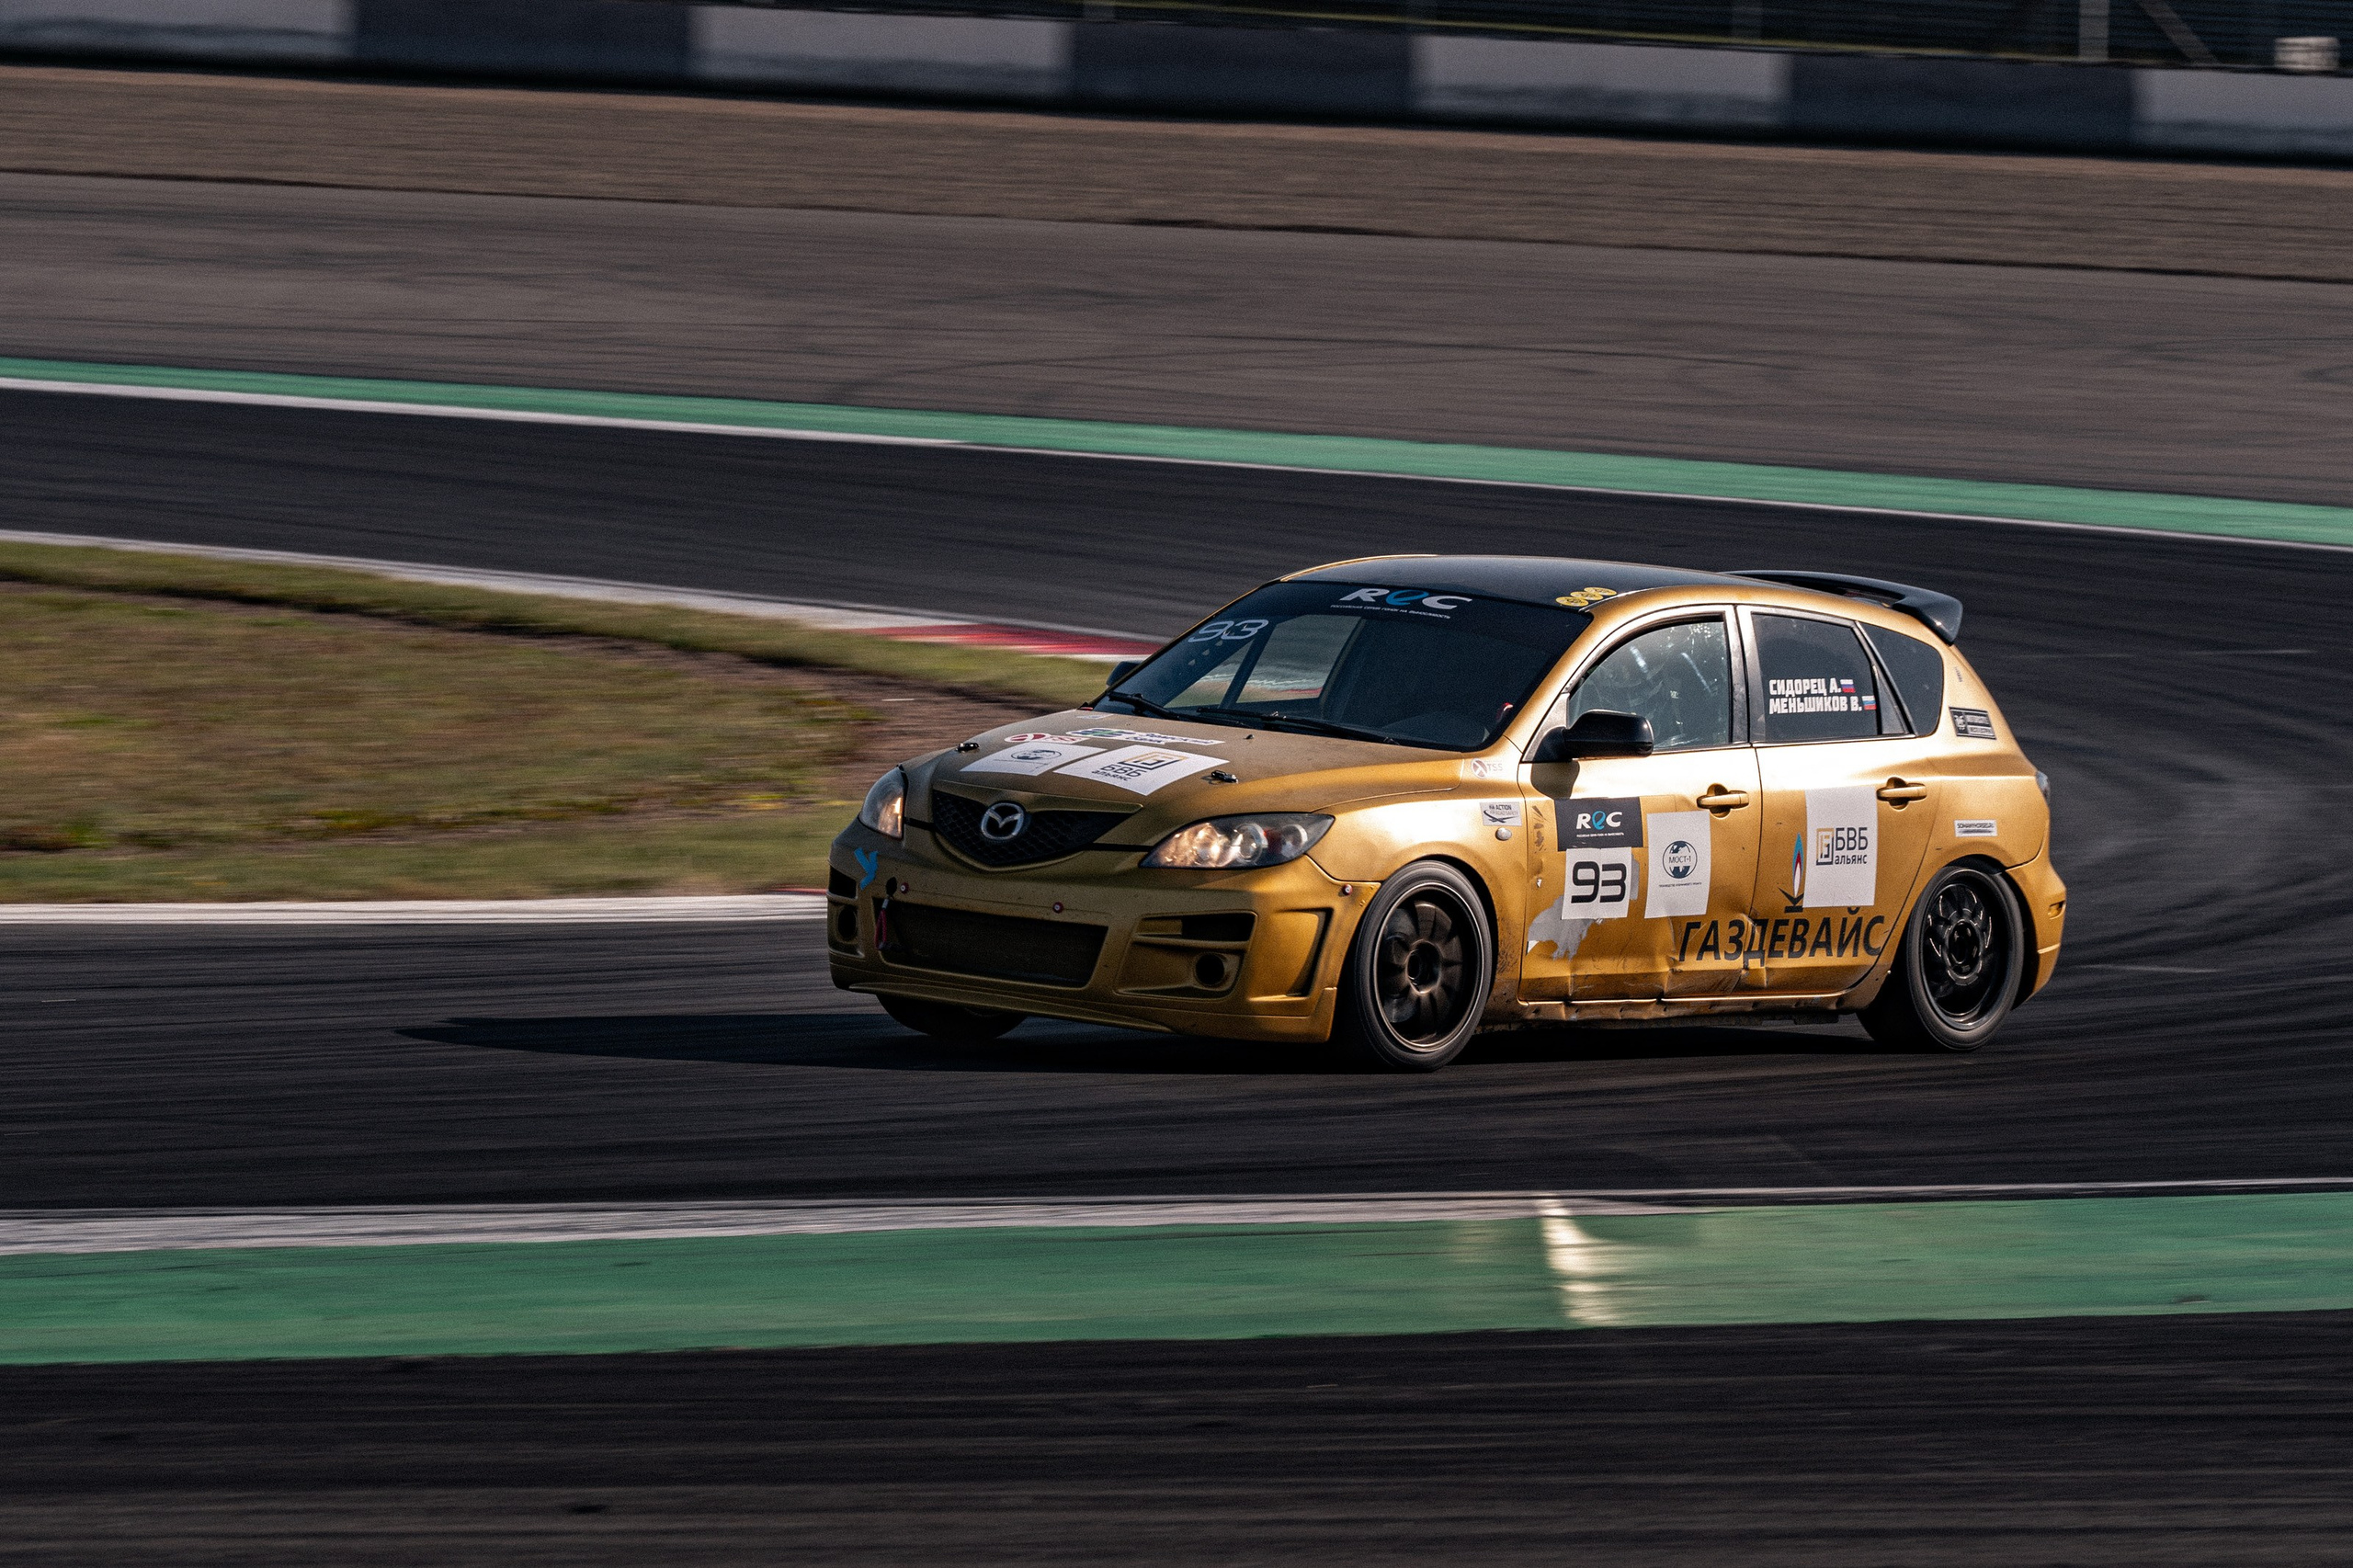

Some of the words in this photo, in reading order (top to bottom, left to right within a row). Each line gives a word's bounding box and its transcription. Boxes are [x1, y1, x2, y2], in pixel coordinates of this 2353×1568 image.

[1188, 619, 1268, 642] 93
[1769, 678, 1827, 697] СИДОРЕЦ
[1829, 677, 1841, 693] А.
[1769, 696, 1847, 714] МЕНЬШИКОВ
[1850, 696, 1862, 711] В.
[1101, 764, 1147, 778] БВБ
[1836, 827, 1869, 851] БВБ
[1668, 855, 1691, 863] МОСТ-1
[1835, 855, 1868, 865] альянс
[1571, 861, 1627, 903] 93
[1678, 906, 1884, 969] ГАЗДЕВАЙС
